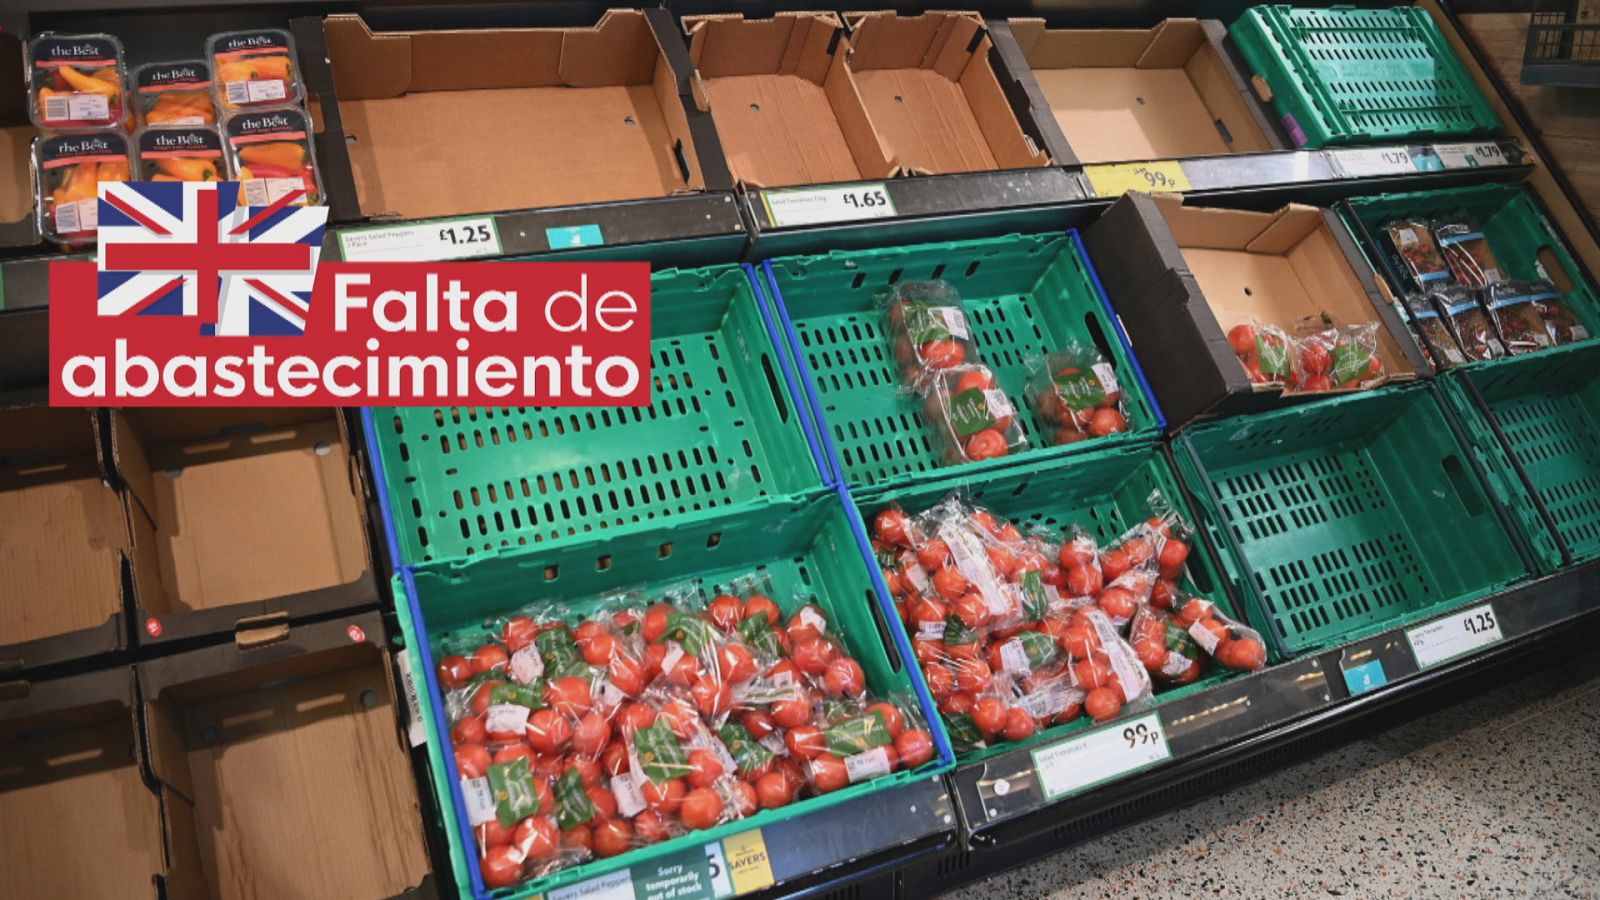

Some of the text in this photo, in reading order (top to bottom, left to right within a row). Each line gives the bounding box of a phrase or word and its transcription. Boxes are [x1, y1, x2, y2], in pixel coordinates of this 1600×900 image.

[51, 44, 100, 56] the Best
[242, 117, 289, 130] the Best
[59, 142, 80, 153] the
[156, 134, 204, 146] the Best
[843, 191, 886, 209] £1.65
[439, 225, 491, 245] £1.25
[1463, 611, 1495, 636] £1.25
[1123, 723, 1159, 748] 99p
[657, 864, 683, 877] Sorry
[579, 883, 600, 895] Salad
[601, 876, 631, 889] Pepper
[645, 870, 699, 892] temporarily
[665, 886, 676, 899] of
[677, 881, 703, 896] stock
